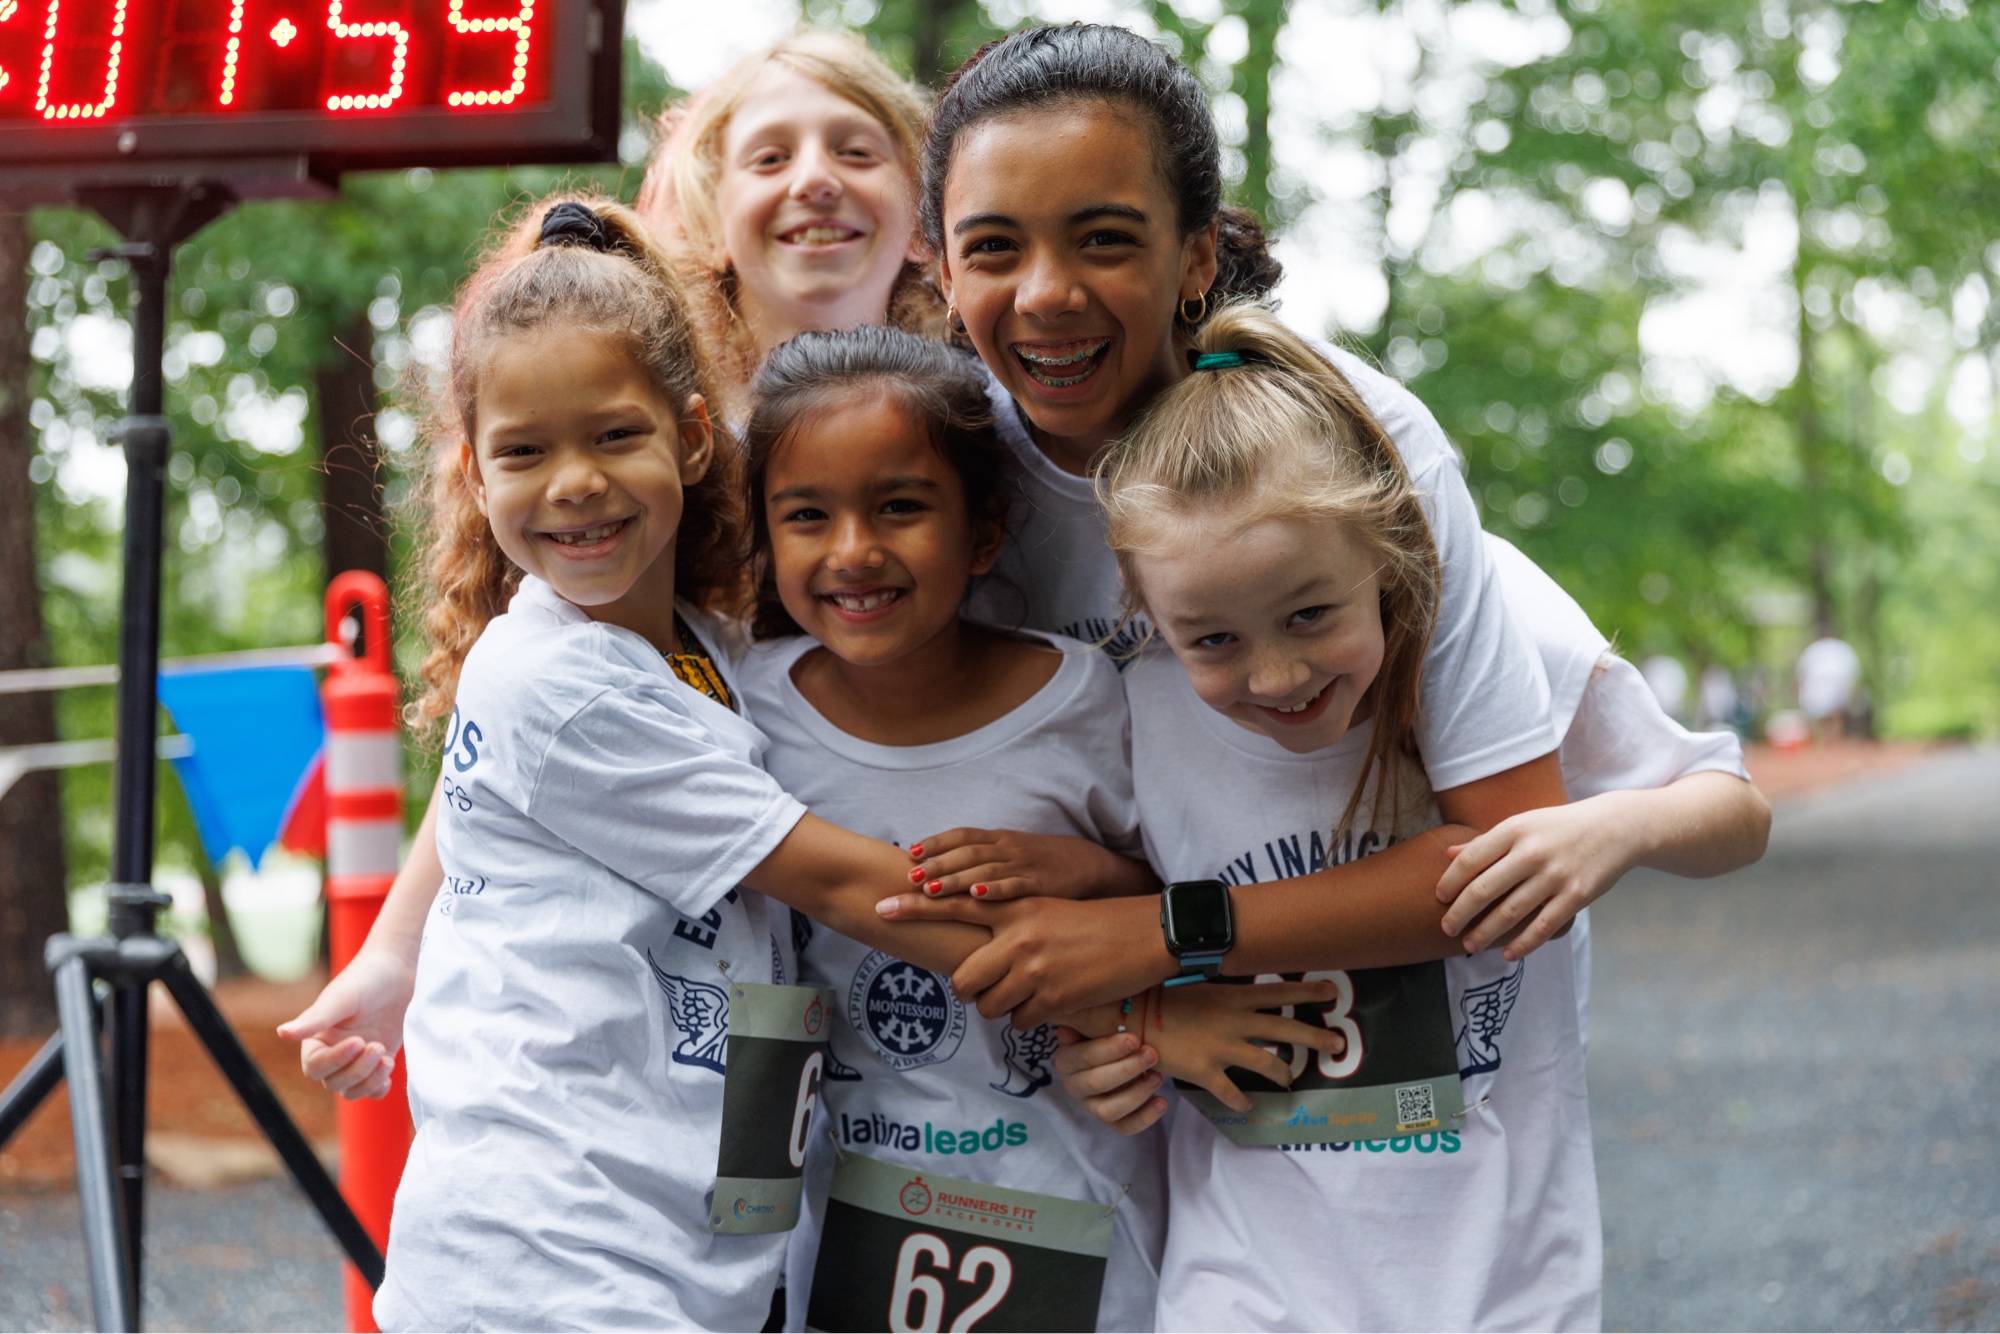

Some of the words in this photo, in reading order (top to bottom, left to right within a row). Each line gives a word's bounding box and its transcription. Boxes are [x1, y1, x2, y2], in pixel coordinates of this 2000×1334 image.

[851, 950, 887, 1031] ALPHARETT
[869, 998, 946, 1020] MONTESSORI
[841, 1112, 1028, 1155] latinaleads
[1302, 1112, 1377, 1127] RunSignUp
[935, 1207, 1034, 1232] RACEWORKS
[938, 1192, 1008, 1216] RUNNERS
[1013, 1206, 1036, 1220] FIT
[888, 1232, 1013, 1334] 62
